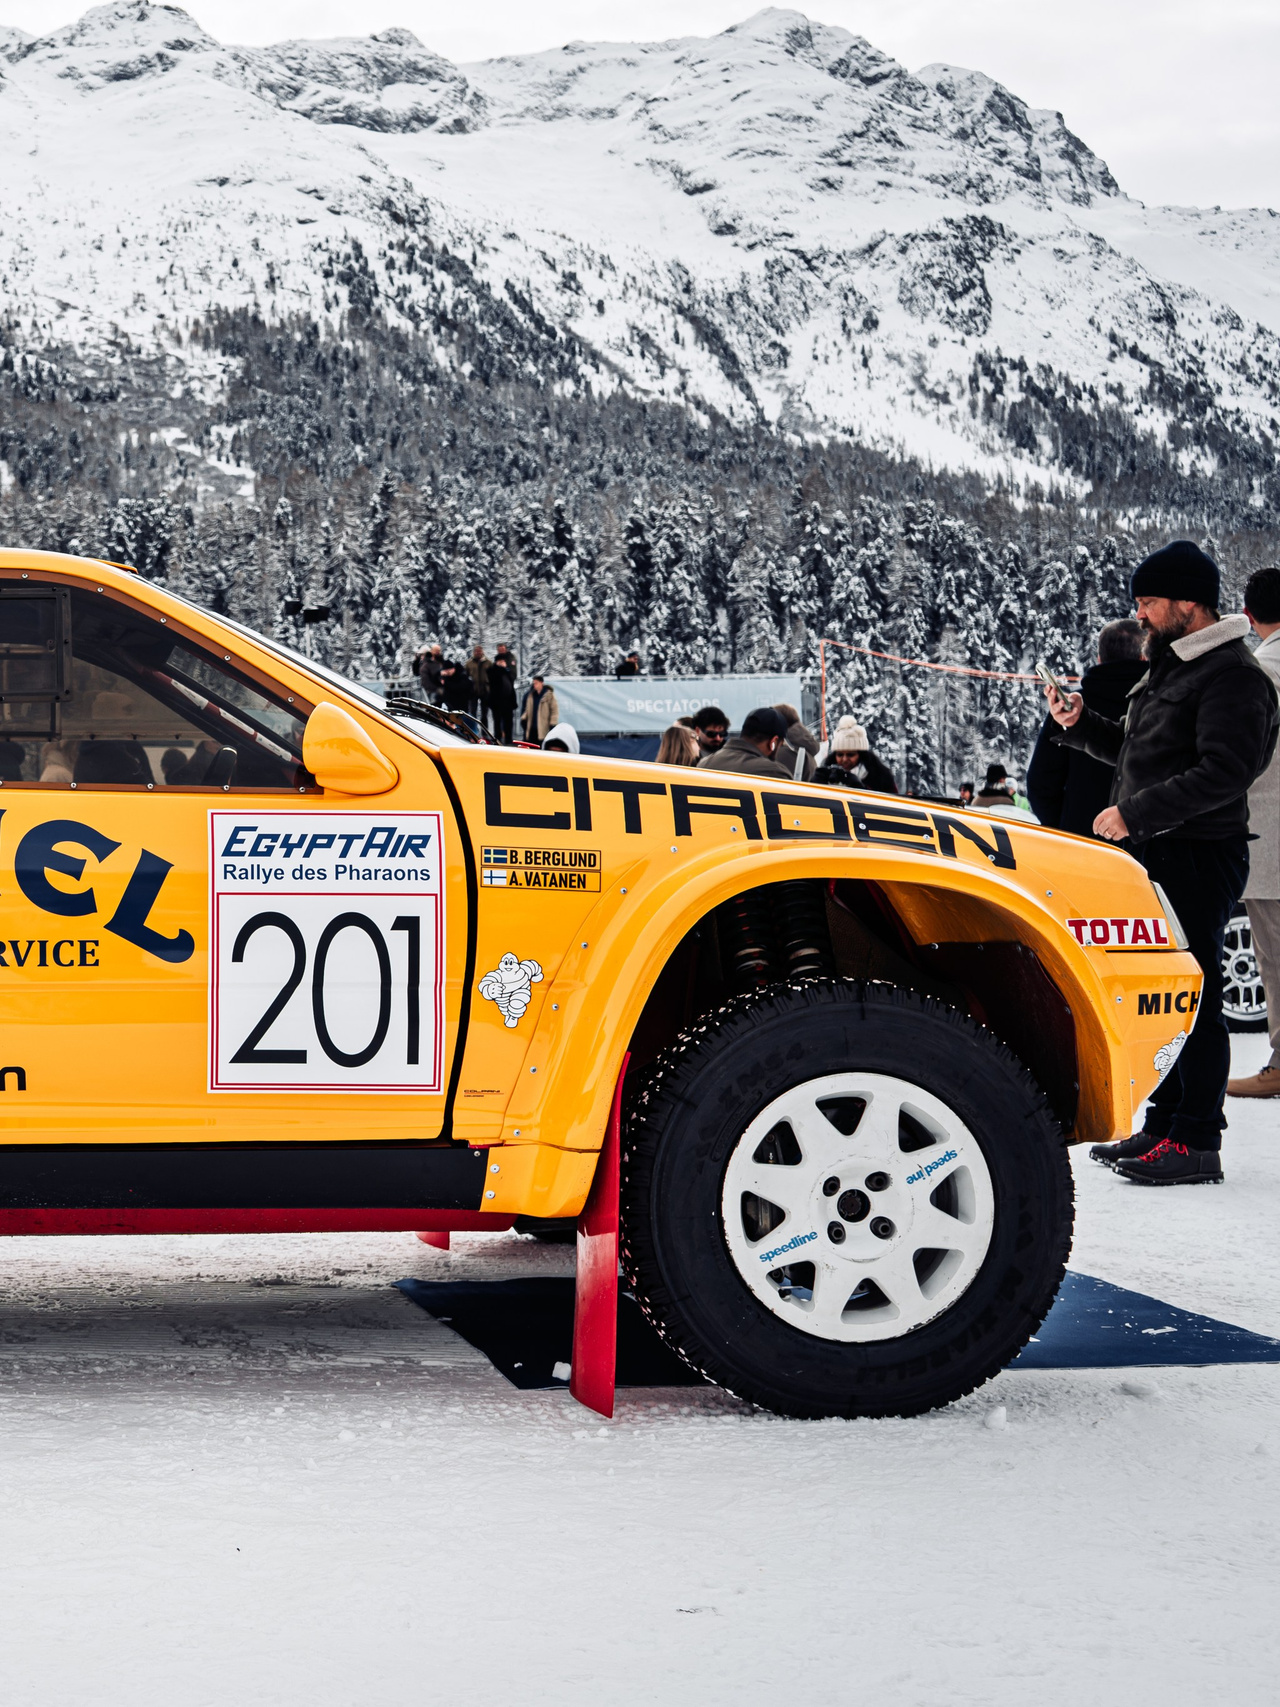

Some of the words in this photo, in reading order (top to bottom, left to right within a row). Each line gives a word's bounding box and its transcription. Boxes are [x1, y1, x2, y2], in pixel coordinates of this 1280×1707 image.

[483, 771, 1017, 871] CITROEN
[510, 850, 522, 865] B.
[524, 850, 597, 867] BERGLUND
[223, 863, 285, 884] Rallye
[291, 864, 328, 881] des
[335, 864, 431, 881] Pharaons
[509, 871, 522, 886] A.
[524, 871, 587, 889] VATANEN
[1067, 919, 1169, 945] TOTAL
[228, 911, 420, 1068] 201
[906, 1150, 958, 1184] speedine
[759, 1231, 818, 1263] speedline
